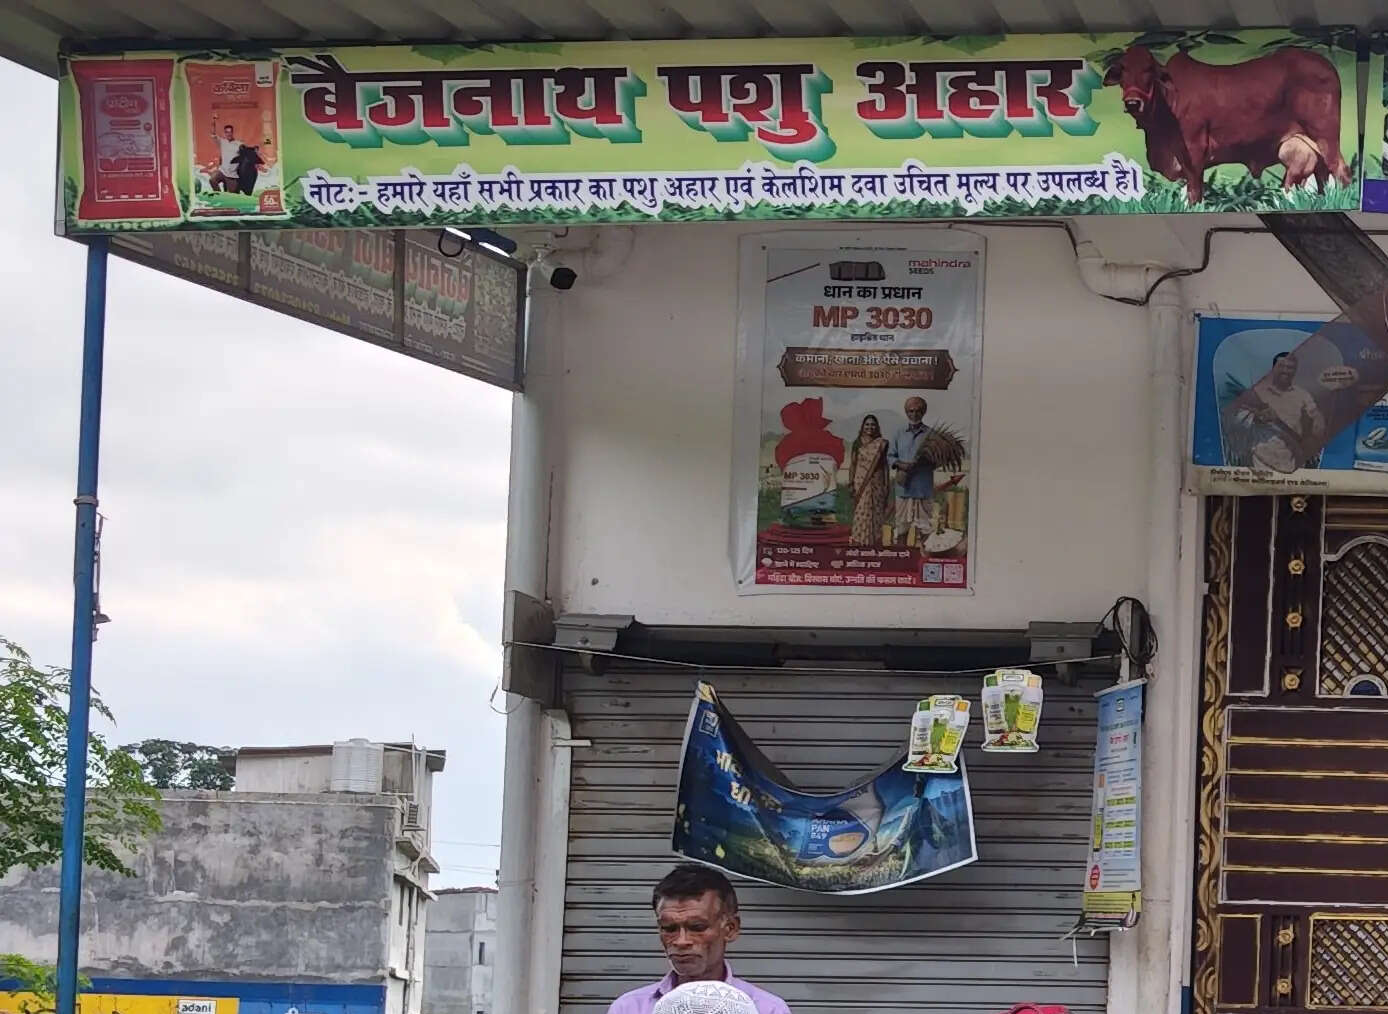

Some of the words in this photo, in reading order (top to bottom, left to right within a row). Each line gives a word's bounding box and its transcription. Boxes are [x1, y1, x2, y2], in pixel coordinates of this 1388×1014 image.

[284, 55, 629, 130] बैजनाथ
[656, 64, 816, 145] पशु
[856, 60, 1084, 121] अहार
[377, 173, 426, 204] हमारे
[432, 170, 471, 202] यहाँ
[477, 170, 526, 202] सभी
[528, 178, 582, 203] प्रकार
[588, 178, 617, 202] का
[621, 178, 658, 209] पशु
[665, 176, 719, 201] अहार
[725, 167, 755, 205] एवं
[851, 173, 887, 199] दवा
[894, 165, 952, 197] उचित
[956, 173, 1000, 204] मूल्य
[1005, 173, 1032, 200] पर
[1037, 171, 1108, 195] उपलब्ध
[907, 258, 972, 268] mahindra
[824, 285, 853, 300] धान
[856, 285, 877, 300] का
[881, 286, 923, 301] प्रधान
[812, 305, 859, 329] MP
[865, 306, 933, 330] 3030
[181, 1003, 212, 1013] adani
